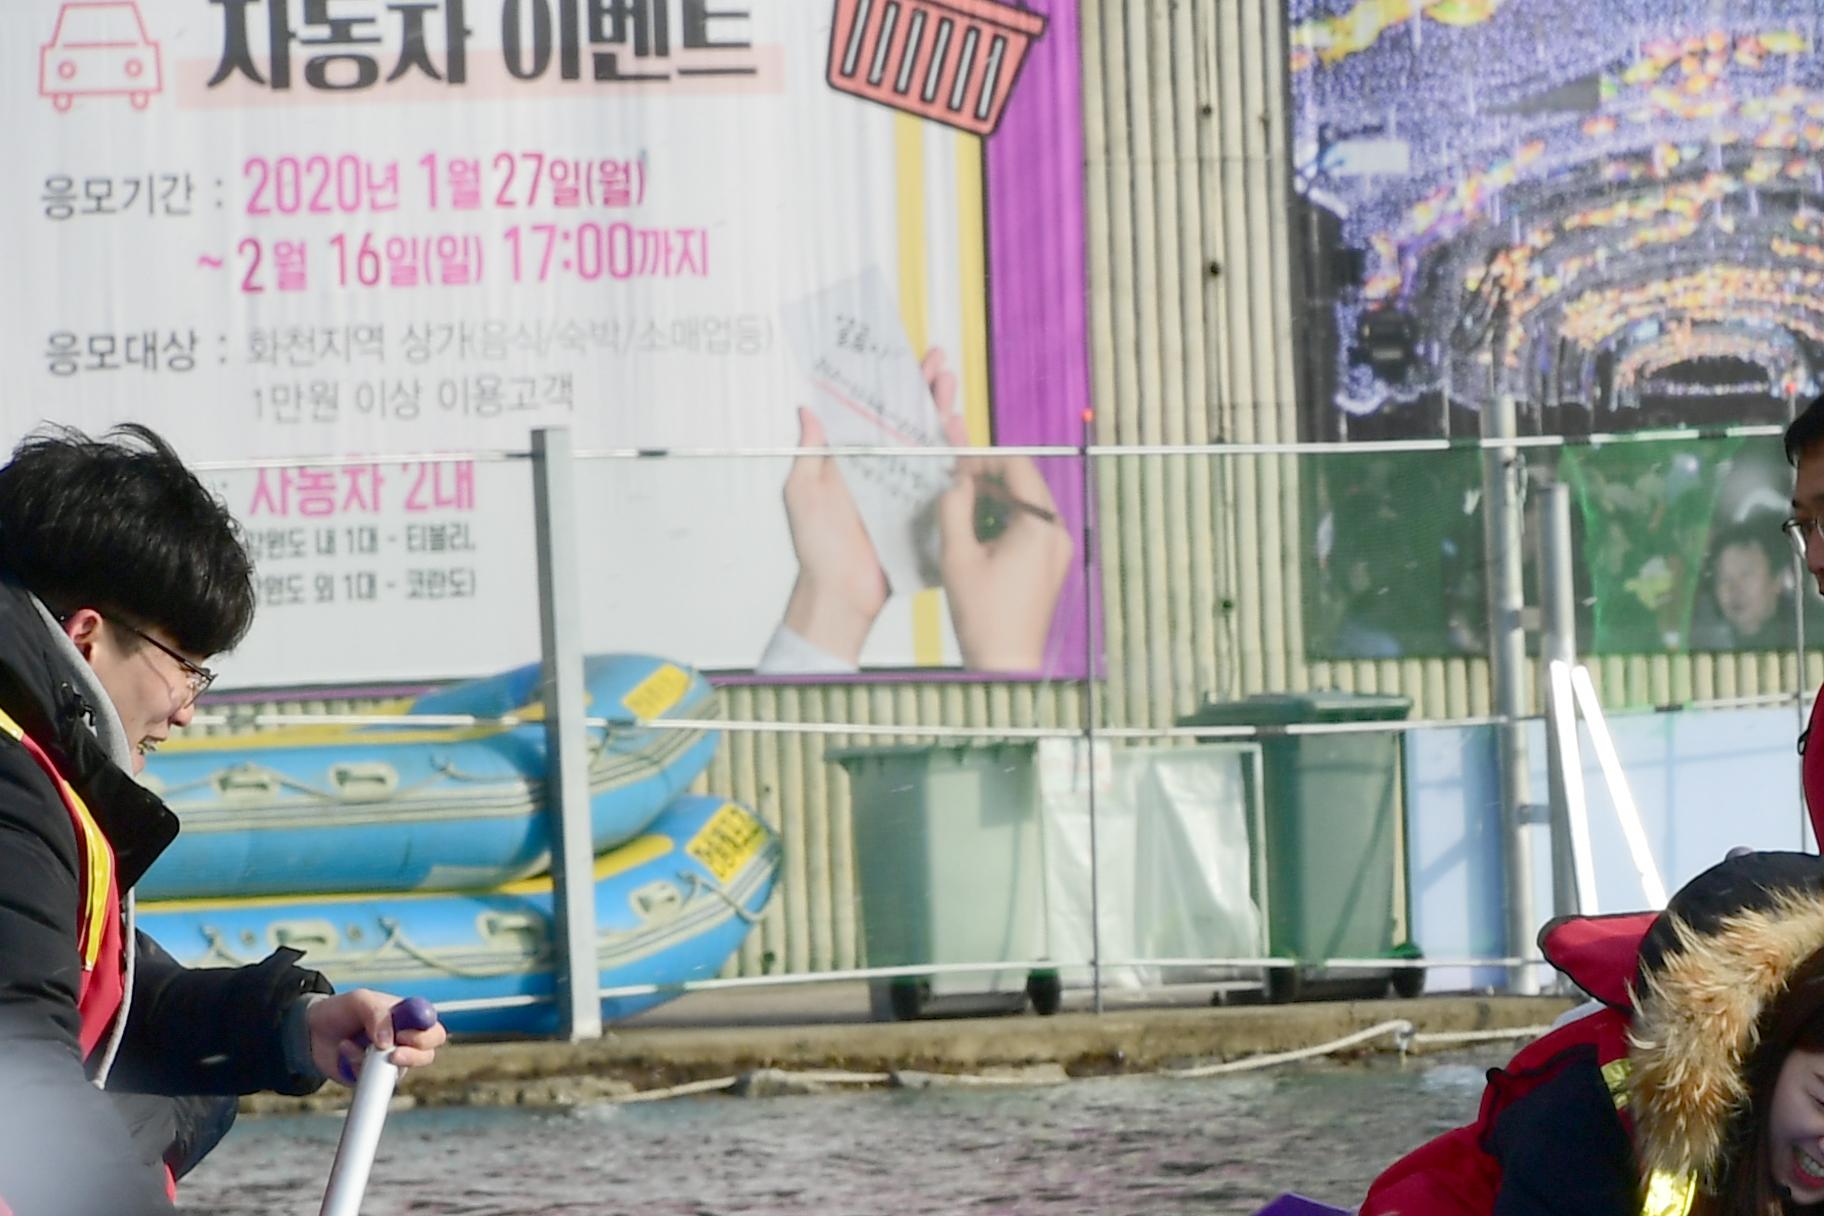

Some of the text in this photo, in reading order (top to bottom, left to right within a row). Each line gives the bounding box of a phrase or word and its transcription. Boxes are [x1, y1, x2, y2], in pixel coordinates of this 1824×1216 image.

[501, 0, 757, 82] 이벤트
[41, 172, 193, 221] 응모기간
[244, 155, 399, 216] 2020년
[418, 152, 481, 209] 1월
[492, 152, 646, 208] 27일(월)
[329, 231, 484, 288] 16일(일)
[503, 222, 710, 283] 17:00까지
[46, 330, 198, 376] 응모대상
[249, 323, 384, 367] 화천지역
[253, 372, 574, 424] 1만원 이상 이용고객
[346, 525, 379, 553] 1대
[344, 570, 377, 600] 1대
